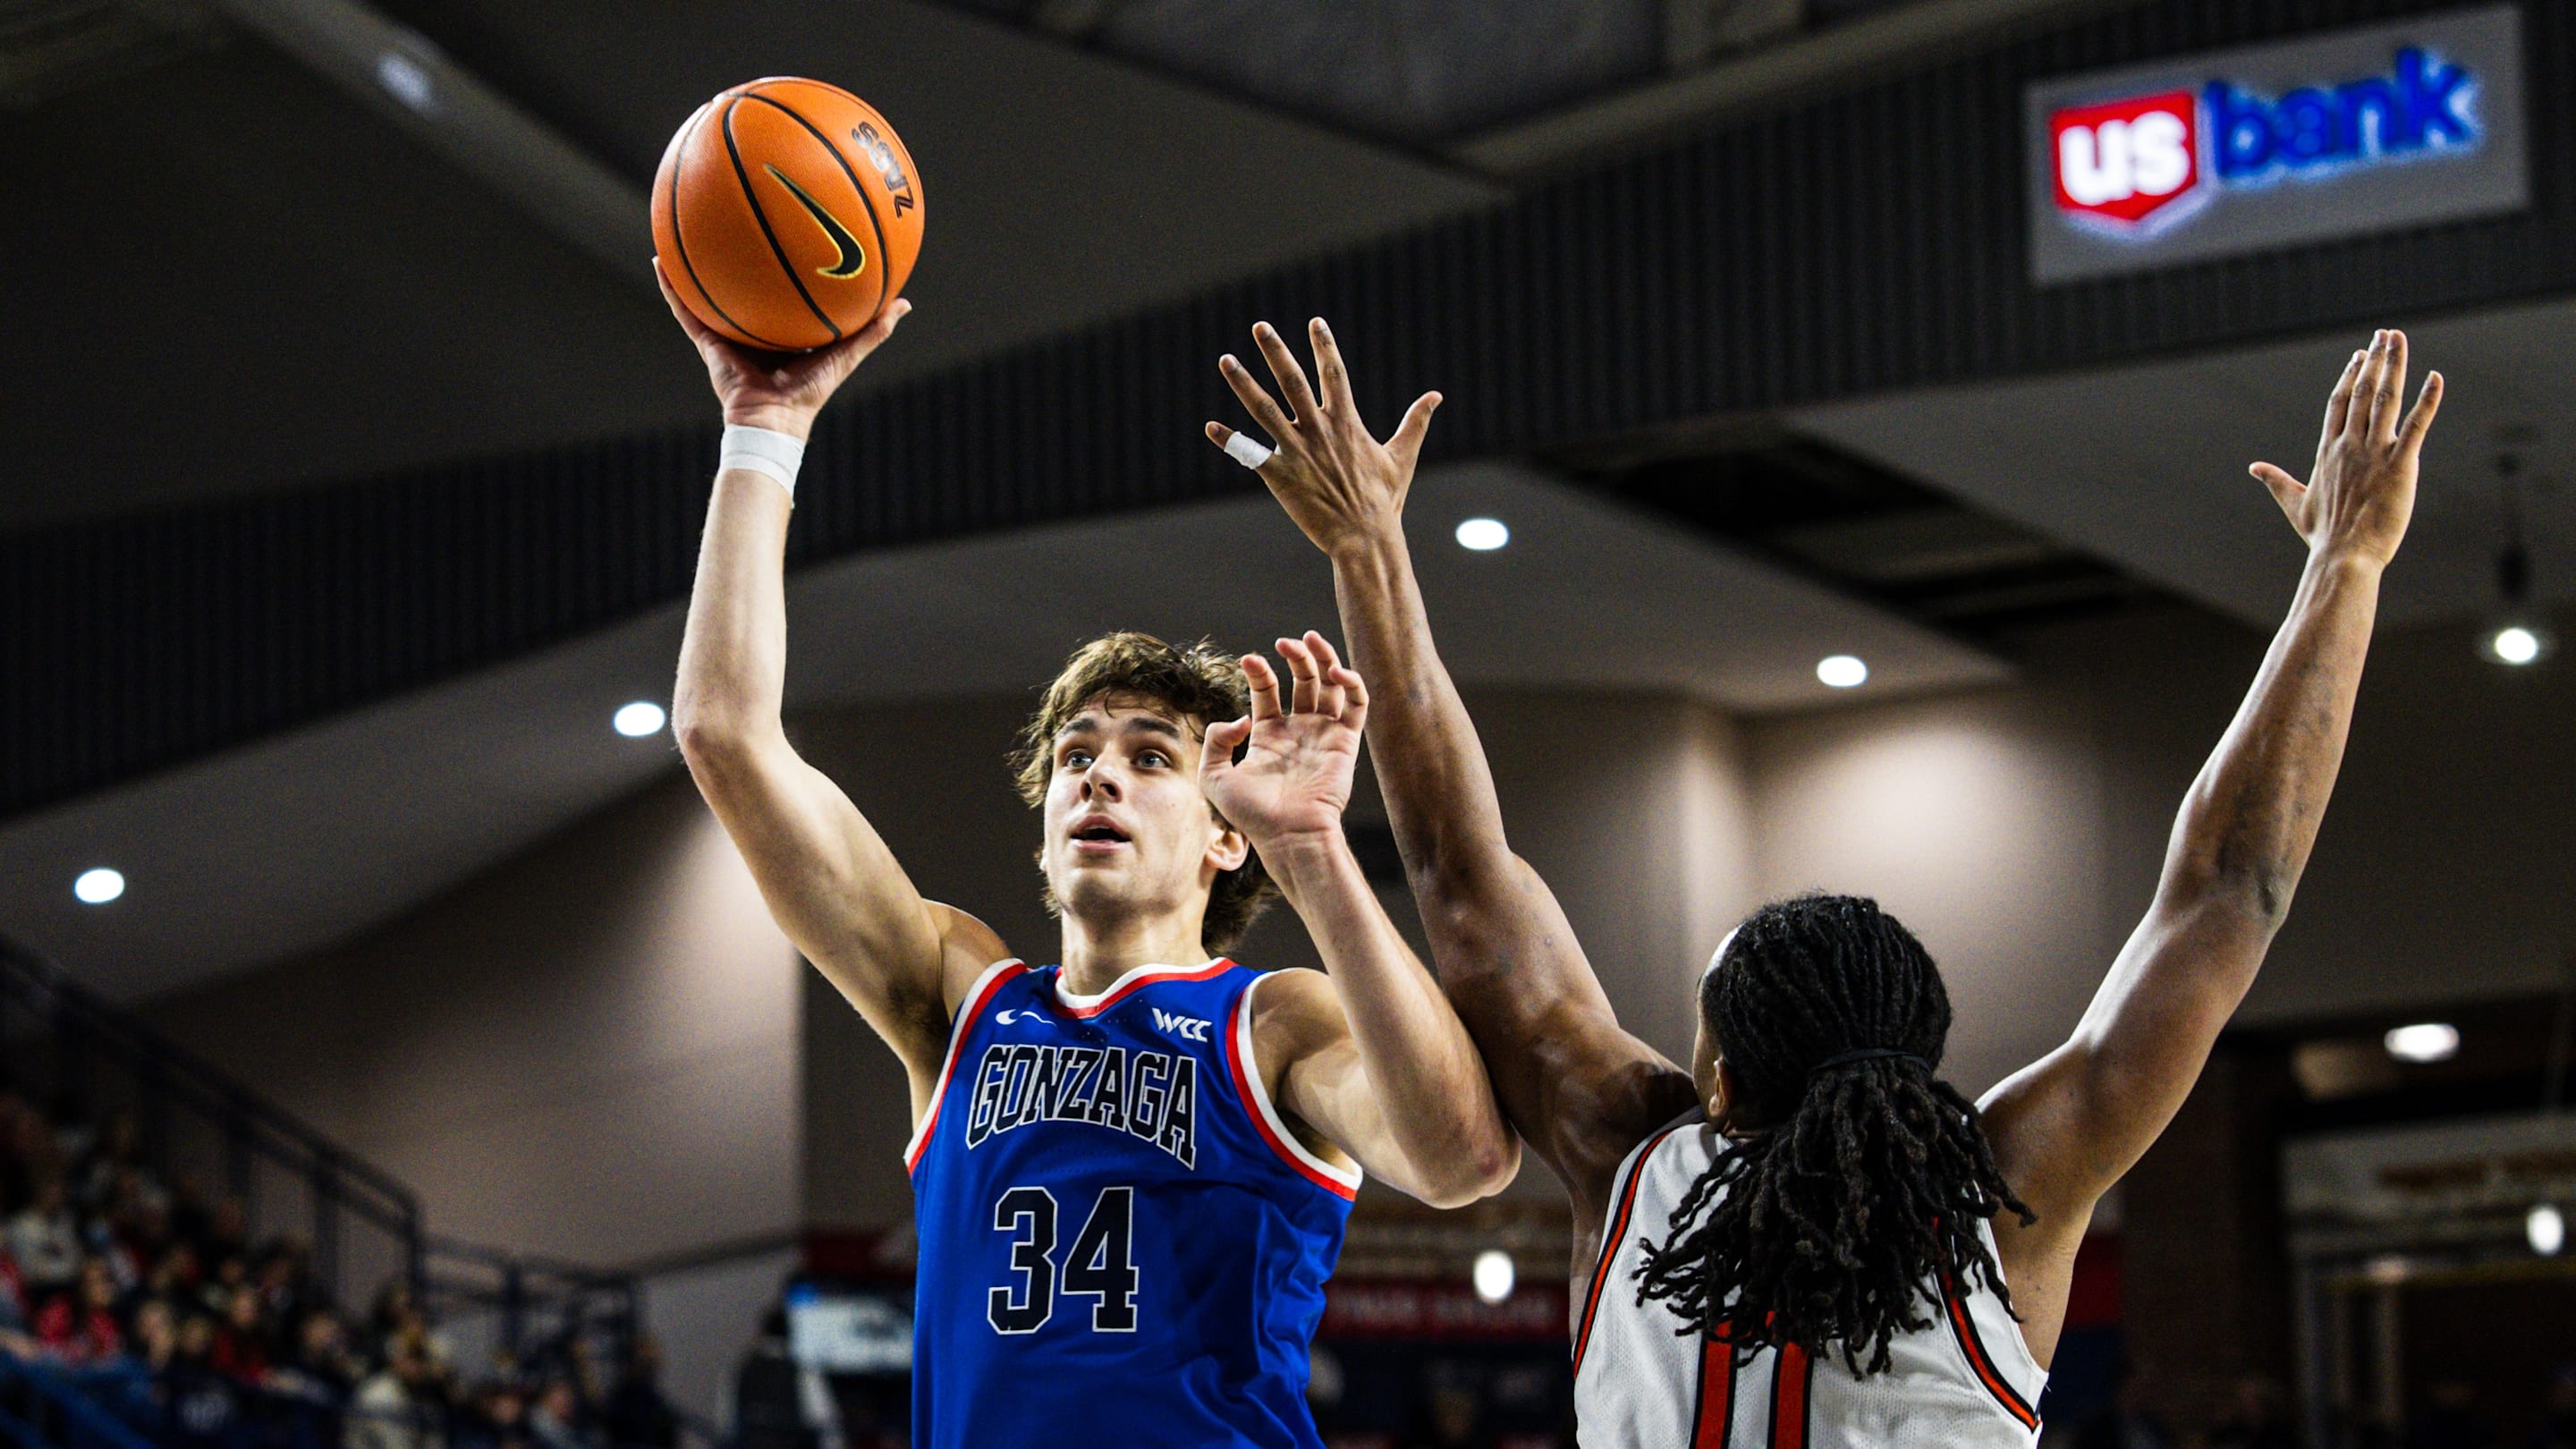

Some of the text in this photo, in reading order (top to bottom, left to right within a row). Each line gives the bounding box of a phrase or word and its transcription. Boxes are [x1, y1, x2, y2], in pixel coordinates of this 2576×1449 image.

[852, 121, 914, 218] ZAGS
[2203, 45, 2476, 182] bank
[1151, 1007, 1213, 1044] WCC
[965, 1045, 1197, 1171] GONZAGA
[987, 1186, 1139, 1335] 34
